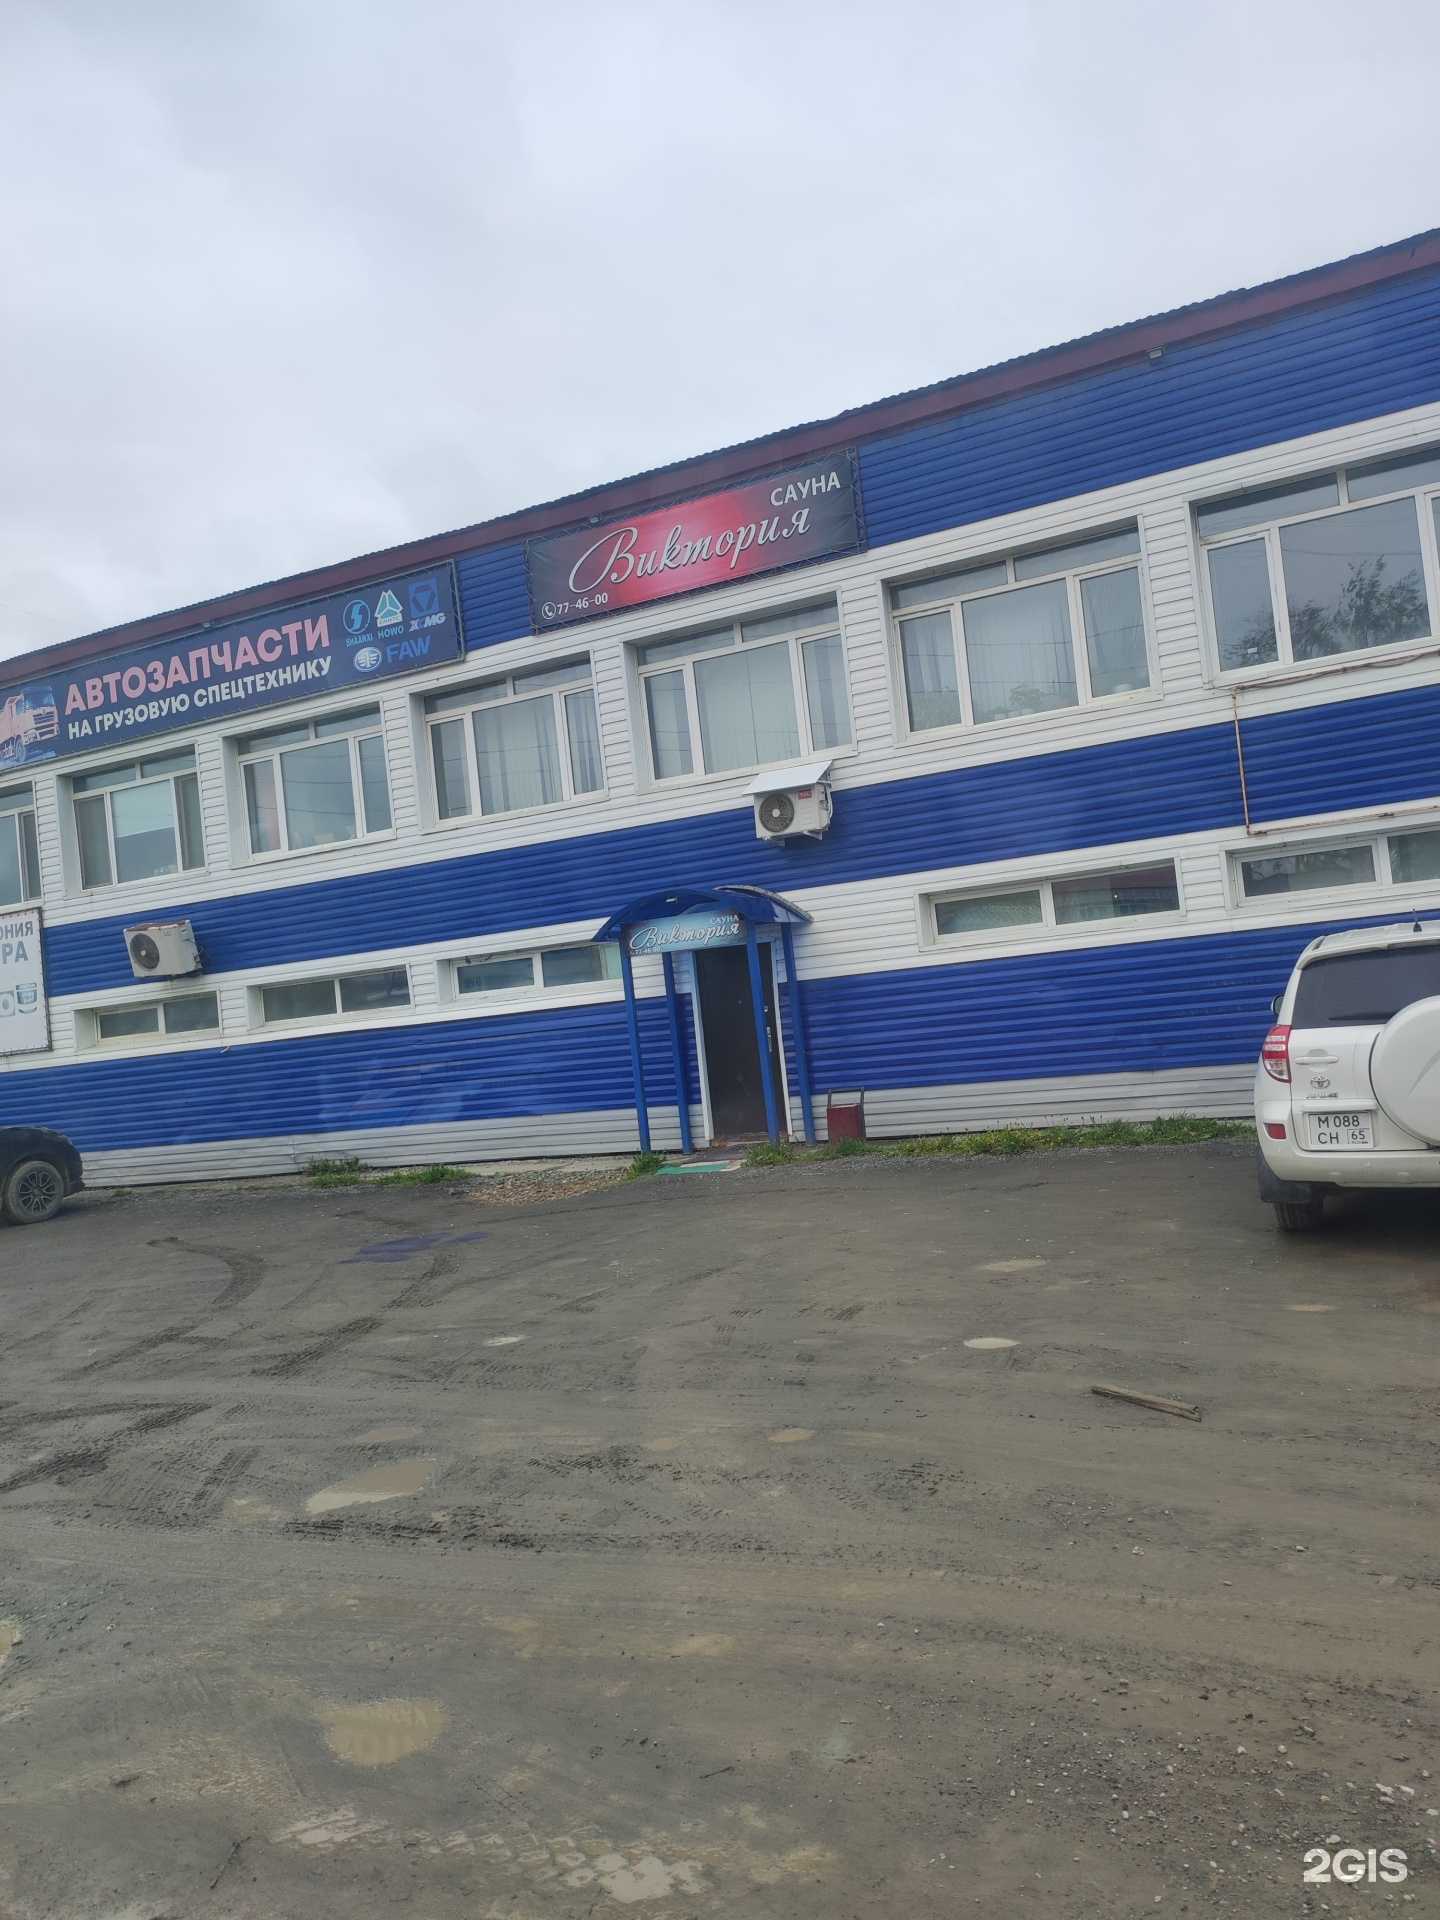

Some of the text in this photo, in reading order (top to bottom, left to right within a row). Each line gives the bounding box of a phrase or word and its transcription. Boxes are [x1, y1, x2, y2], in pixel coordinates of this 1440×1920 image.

[771, 471, 841, 506] САУНА
[568, 506, 811, 594] Виктория
[557, 592, 608, 615] 77-46-00
[377, 624, 404, 640] HOWO
[387, 634, 432, 662] FAW
[64, 614, 330, 716] АВТОЗАПЧАСТИ
[68, 655, 332, 740] НА ГРУЗОВУЮ СПЕЦТЕХНИКУ
[629, 922, 741, 949] Виктория
[1333, 1115, 1360, 1128] 088
[1317, 1131, 1340, 1144] СН
[1351, 1130, 1366, 1141] 65
